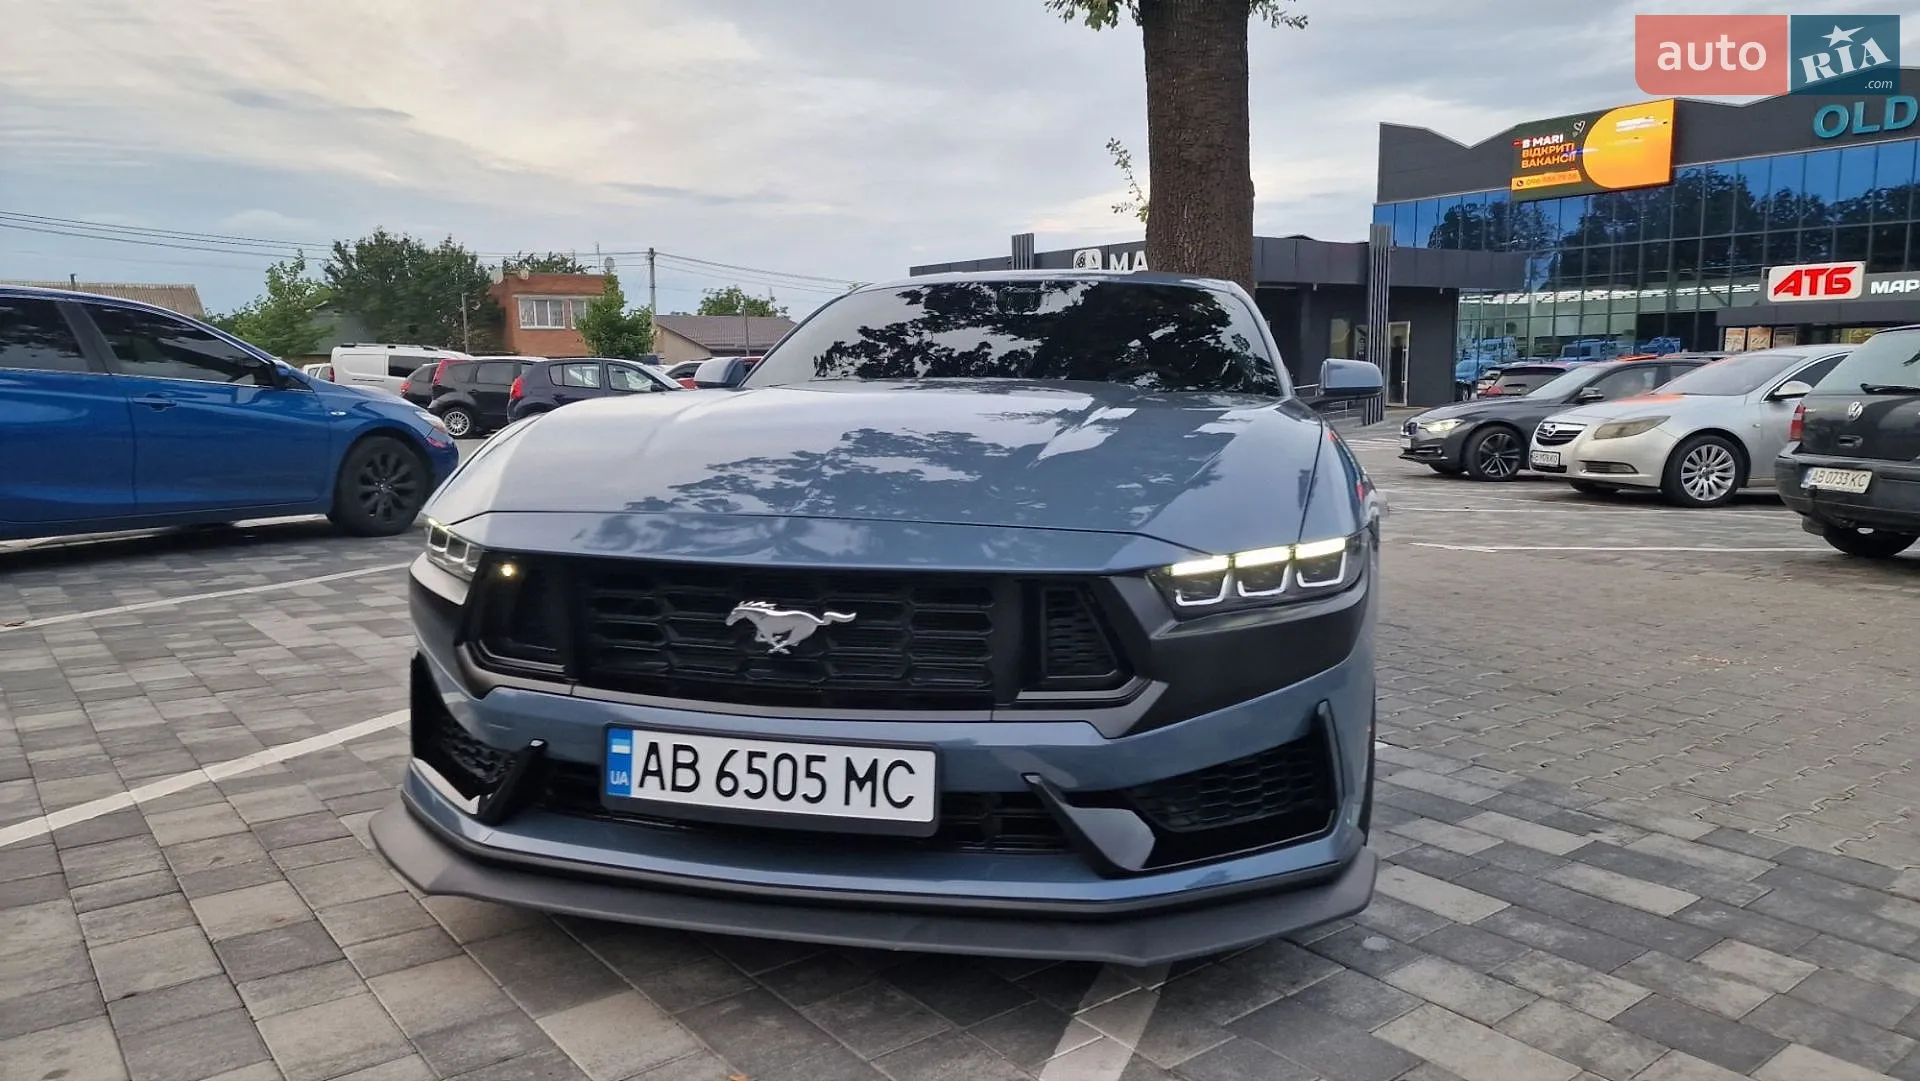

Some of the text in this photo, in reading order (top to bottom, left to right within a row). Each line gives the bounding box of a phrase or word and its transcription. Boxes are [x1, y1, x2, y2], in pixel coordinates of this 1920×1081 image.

[1813, 95, 1919, 139] OLD
[1850, 473, 1867, 487] KC
[610, 770, 630, 786] UA
[638, 741, 916, 809] AB 6505 MC
